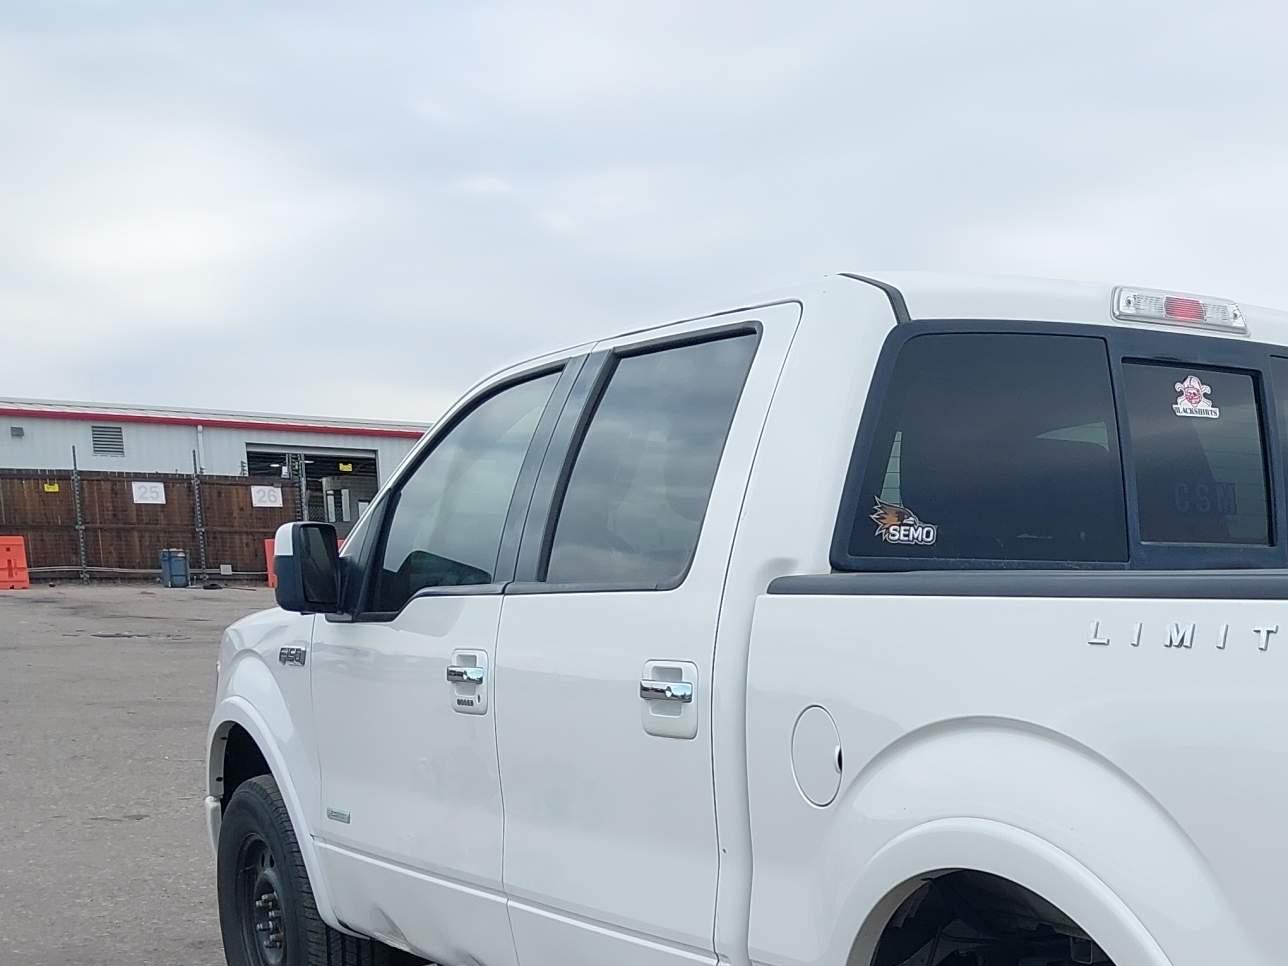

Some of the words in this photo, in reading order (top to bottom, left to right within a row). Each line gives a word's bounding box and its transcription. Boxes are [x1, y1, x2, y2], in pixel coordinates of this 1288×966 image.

[136, 484, 161, 500] 25
[256, 488, 277, 503] 26
[888, 524, 934, 542] SEMO
